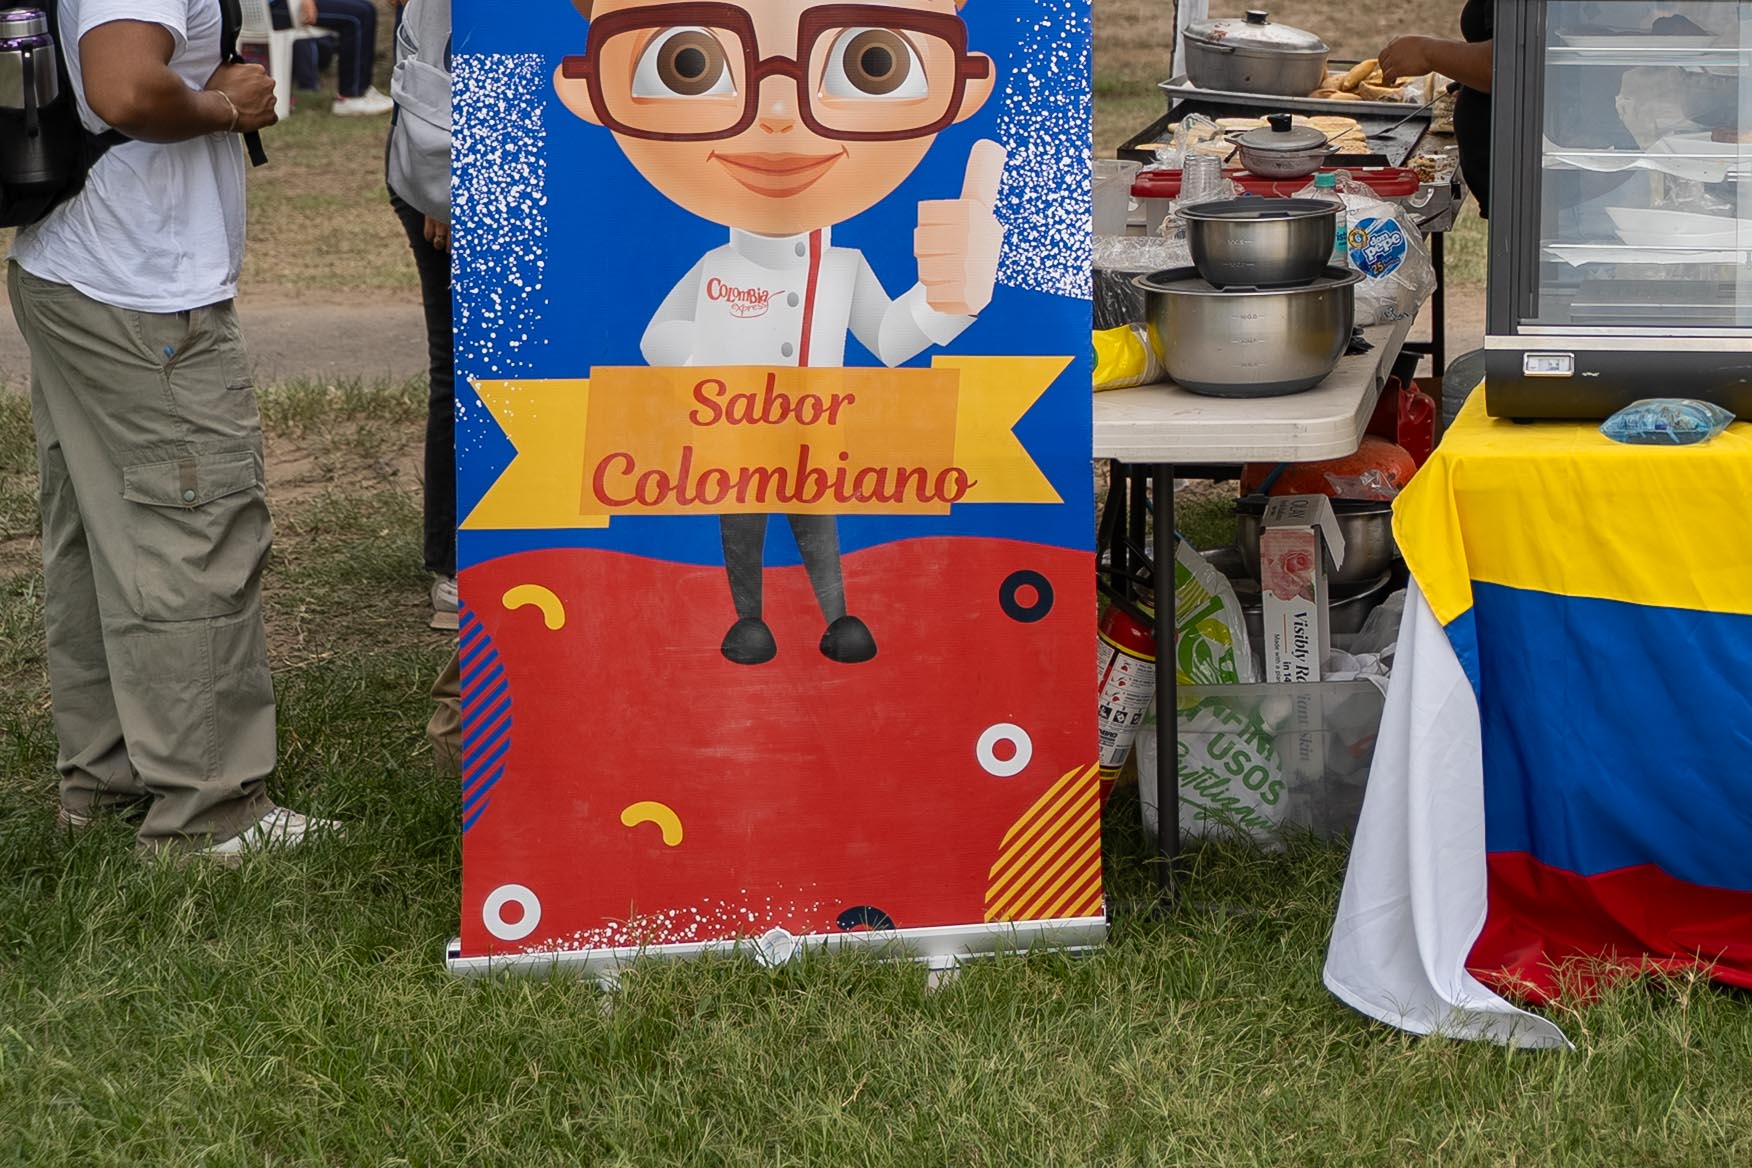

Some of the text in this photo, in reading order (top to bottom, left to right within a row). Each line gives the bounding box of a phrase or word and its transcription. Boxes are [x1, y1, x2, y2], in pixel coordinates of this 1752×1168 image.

[1365, 232, 1401, 262] pepe
[1370, 232, 1389, 246] don
[689, 372, 855, 426] Sabor
[592, 444, 978, 506] Colombiano
[1292, 612, 1309, 663] Visibly
[1283, 661, 1291, 670] in
[1207, 733, 1286, 806] USOS
